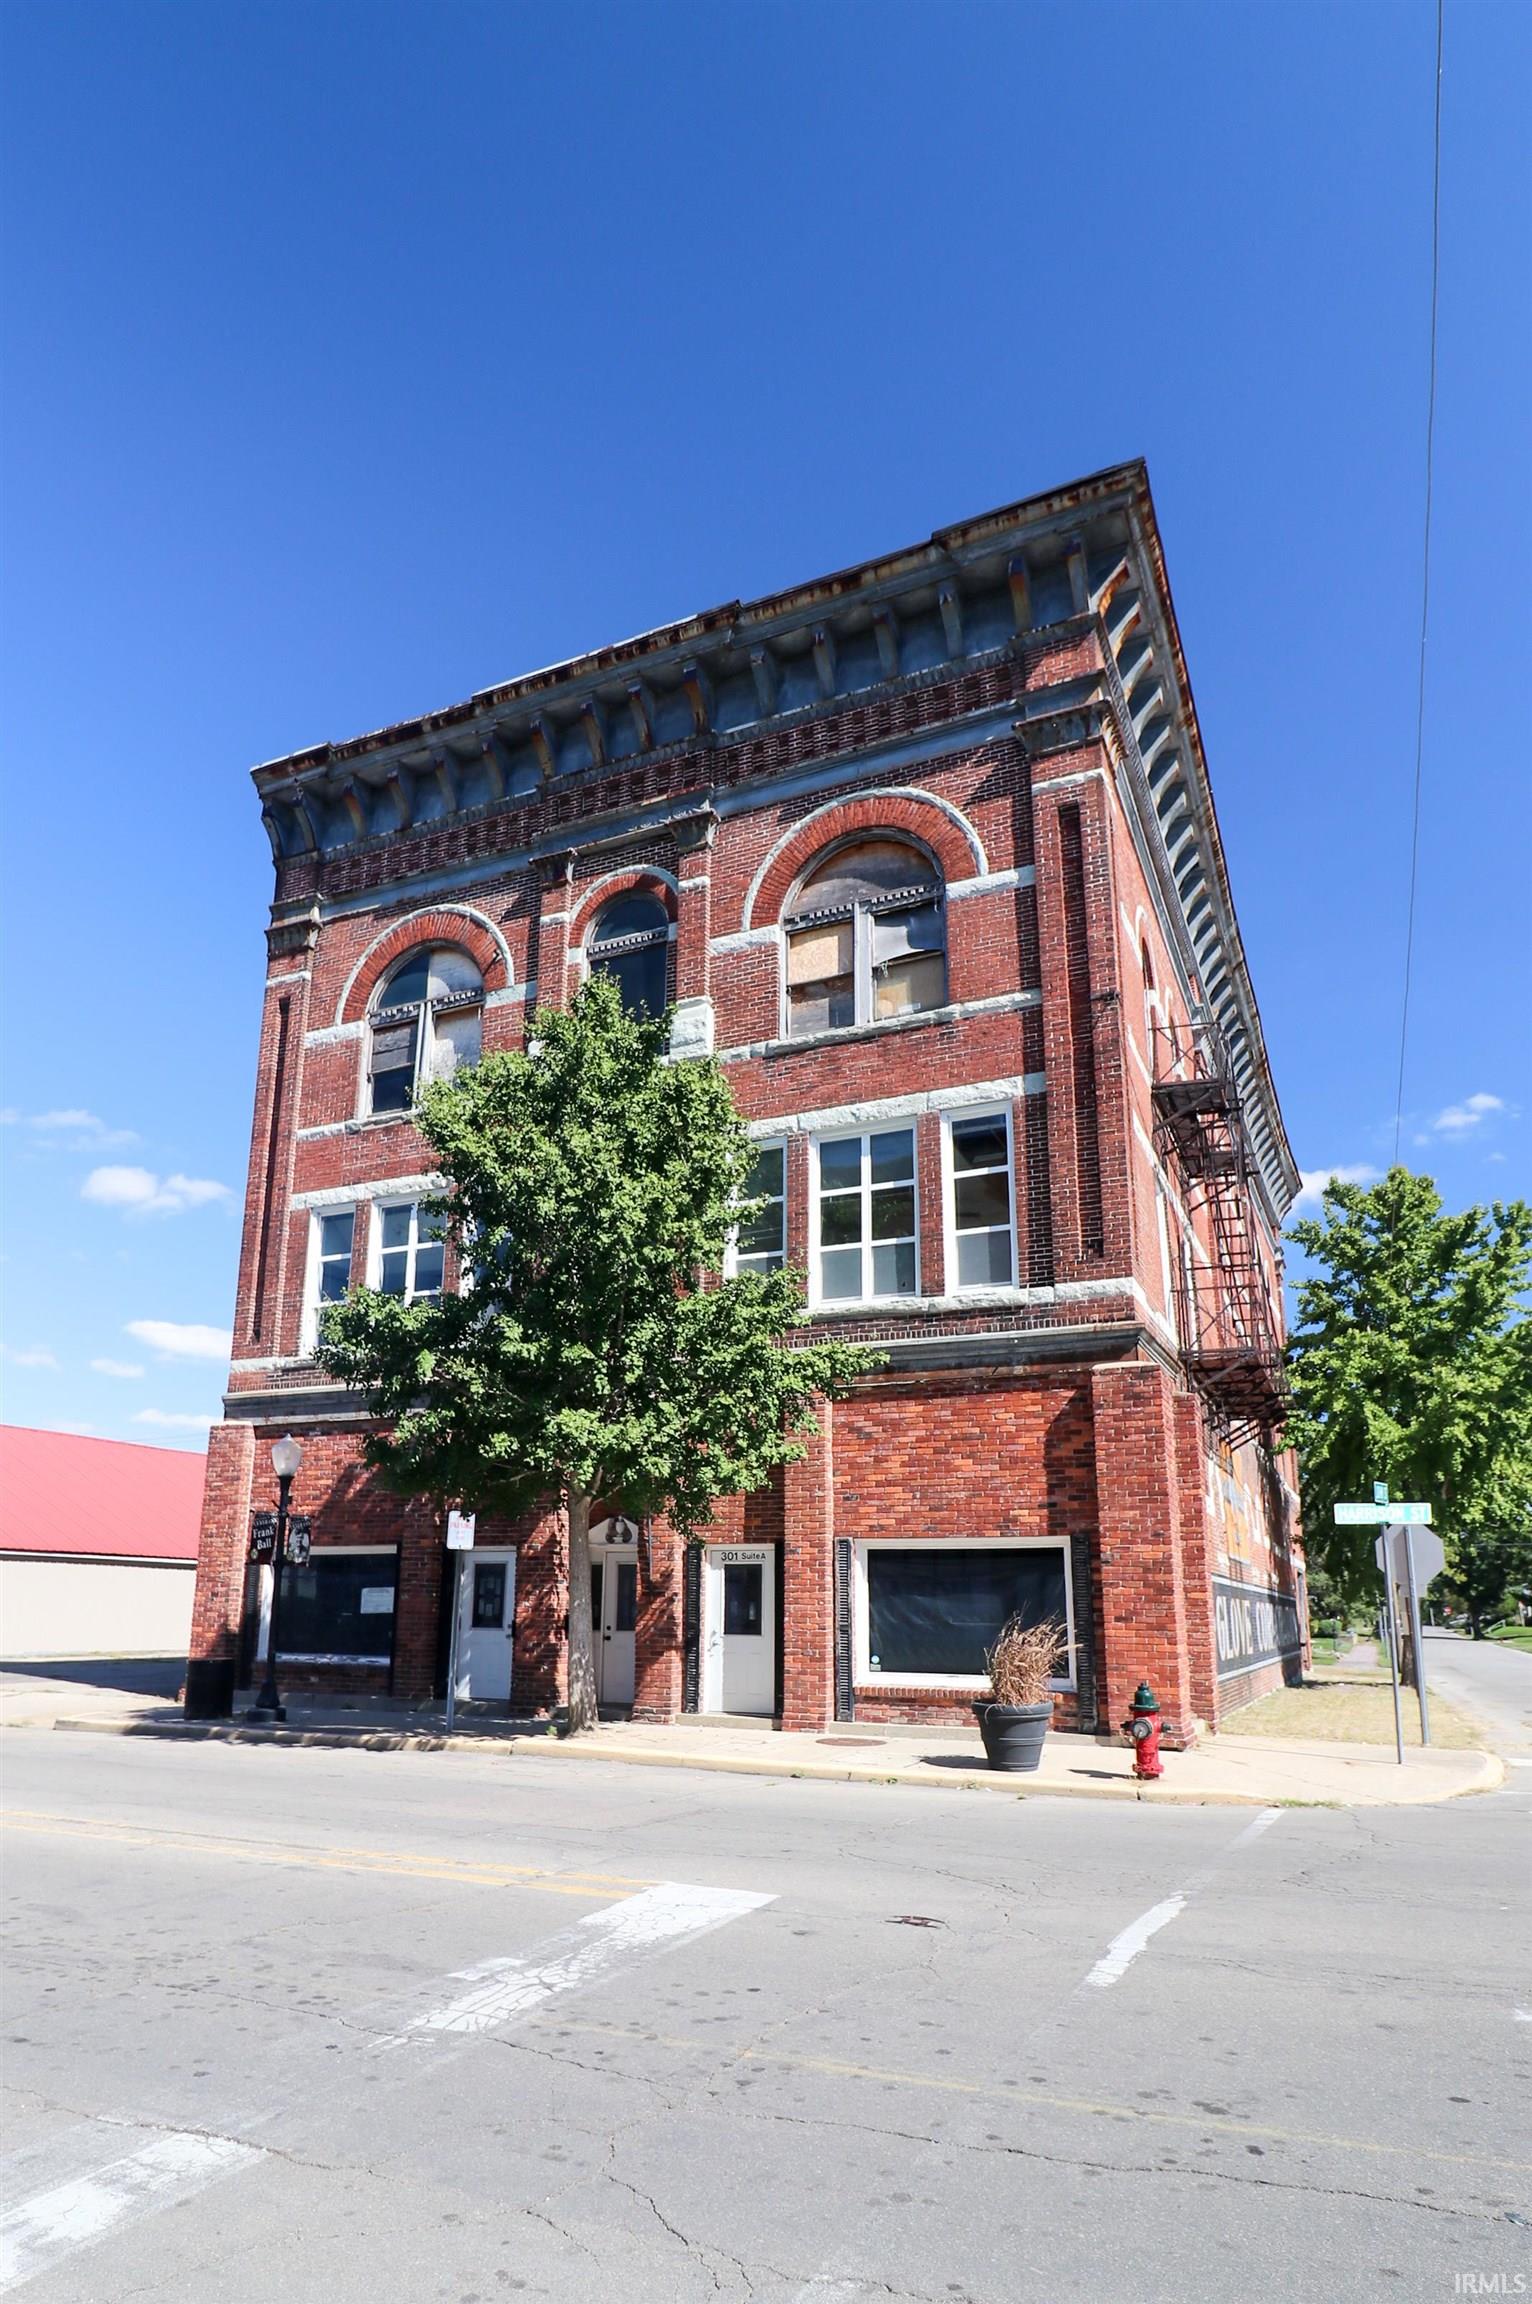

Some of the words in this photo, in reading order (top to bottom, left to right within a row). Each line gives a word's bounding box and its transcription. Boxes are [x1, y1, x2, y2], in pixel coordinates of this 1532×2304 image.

[1338, 1507, 1404, 1521] HARRISON
[1410, 1507, 1428, 1521] ST
[253, 1524, 274, 1539] Frank
[257, 1537, 272, 1550] Ball
[721, 1551, 738, 1561] 301
[1216, 1594, 1254, 1661] GLOVE
